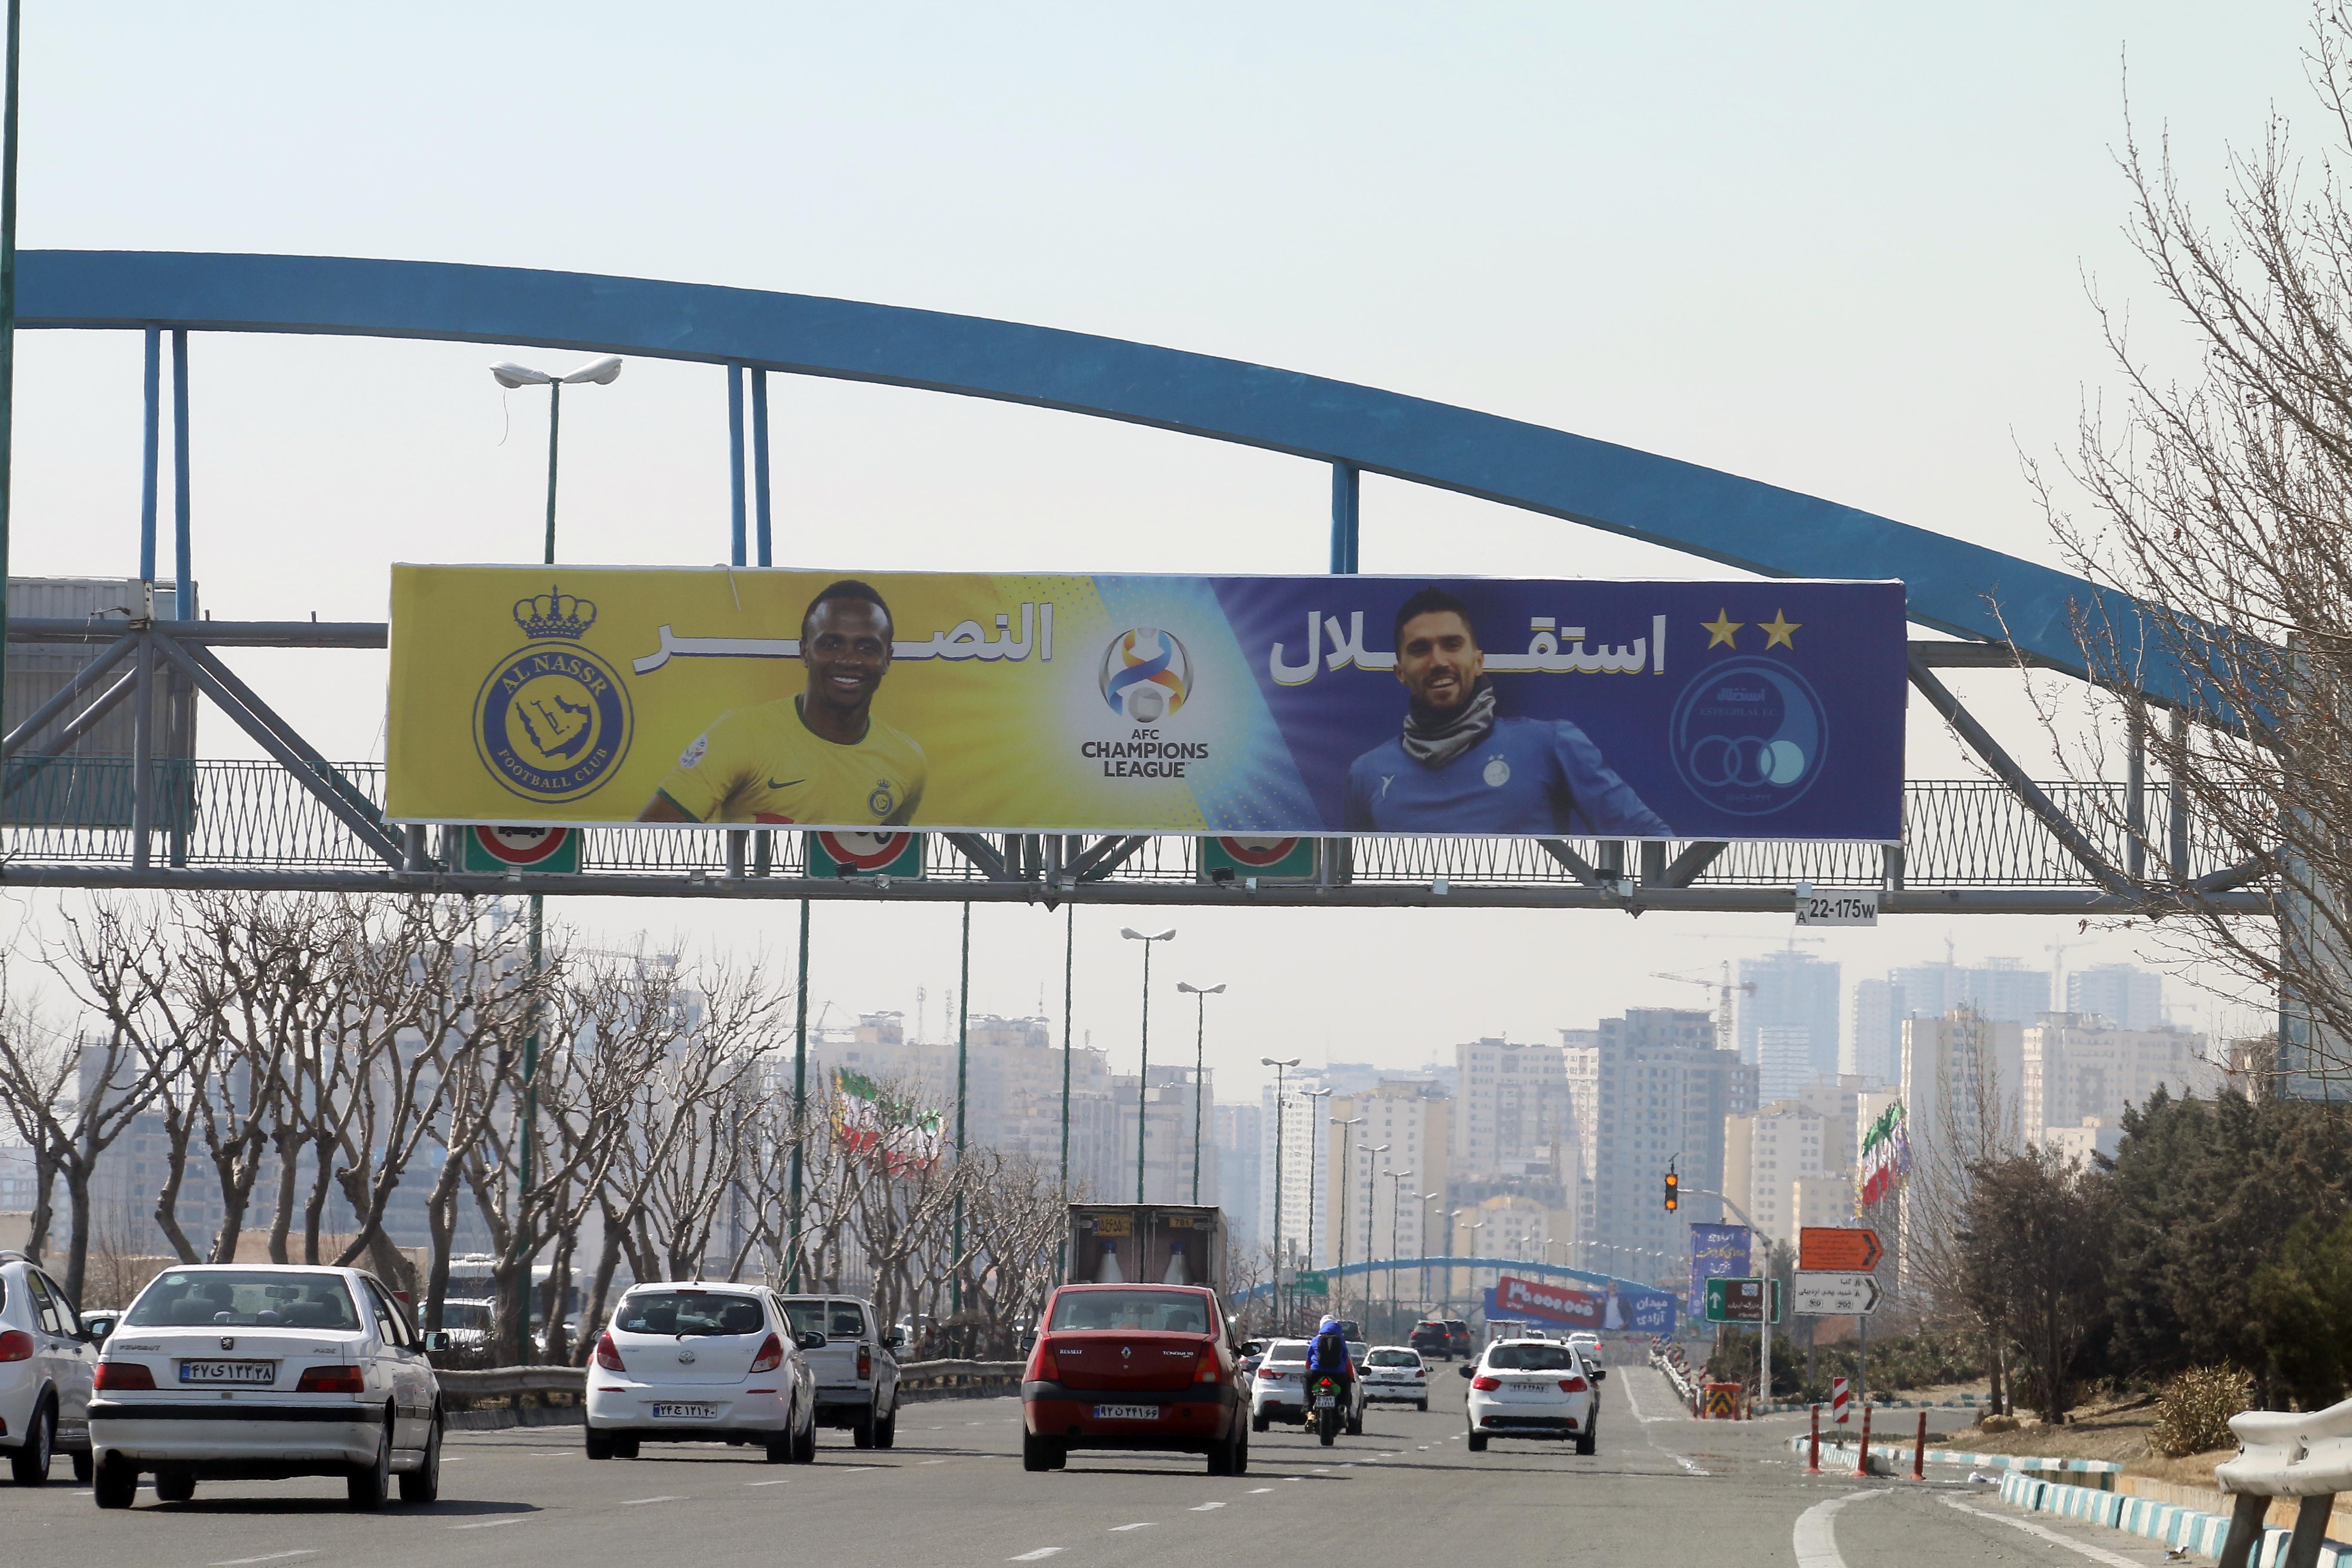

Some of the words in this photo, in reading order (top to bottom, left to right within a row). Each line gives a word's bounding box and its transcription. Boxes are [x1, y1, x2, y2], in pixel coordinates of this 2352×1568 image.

[632, 602, 1053, 675] النصر
[1270, 610, 1666, 686] استقلال
[502, 666, 530, 694] AL
[532, 655, 608, 697] NASSR
[1131, 729, 1159, 740] AFC
[1081, 741, 1209, 759] CHAMPIONS
[498, 749, 571, 788] FOOTBALL
[575, 748, 607, 781] CLUB
[1104, 761, 1185, 778] LEAGUE
[1796, 911, 1807, 923] A
[1636, 1297, 1668, 1311] میدان
[1636, 1311, 1665, 1326] آزادی
